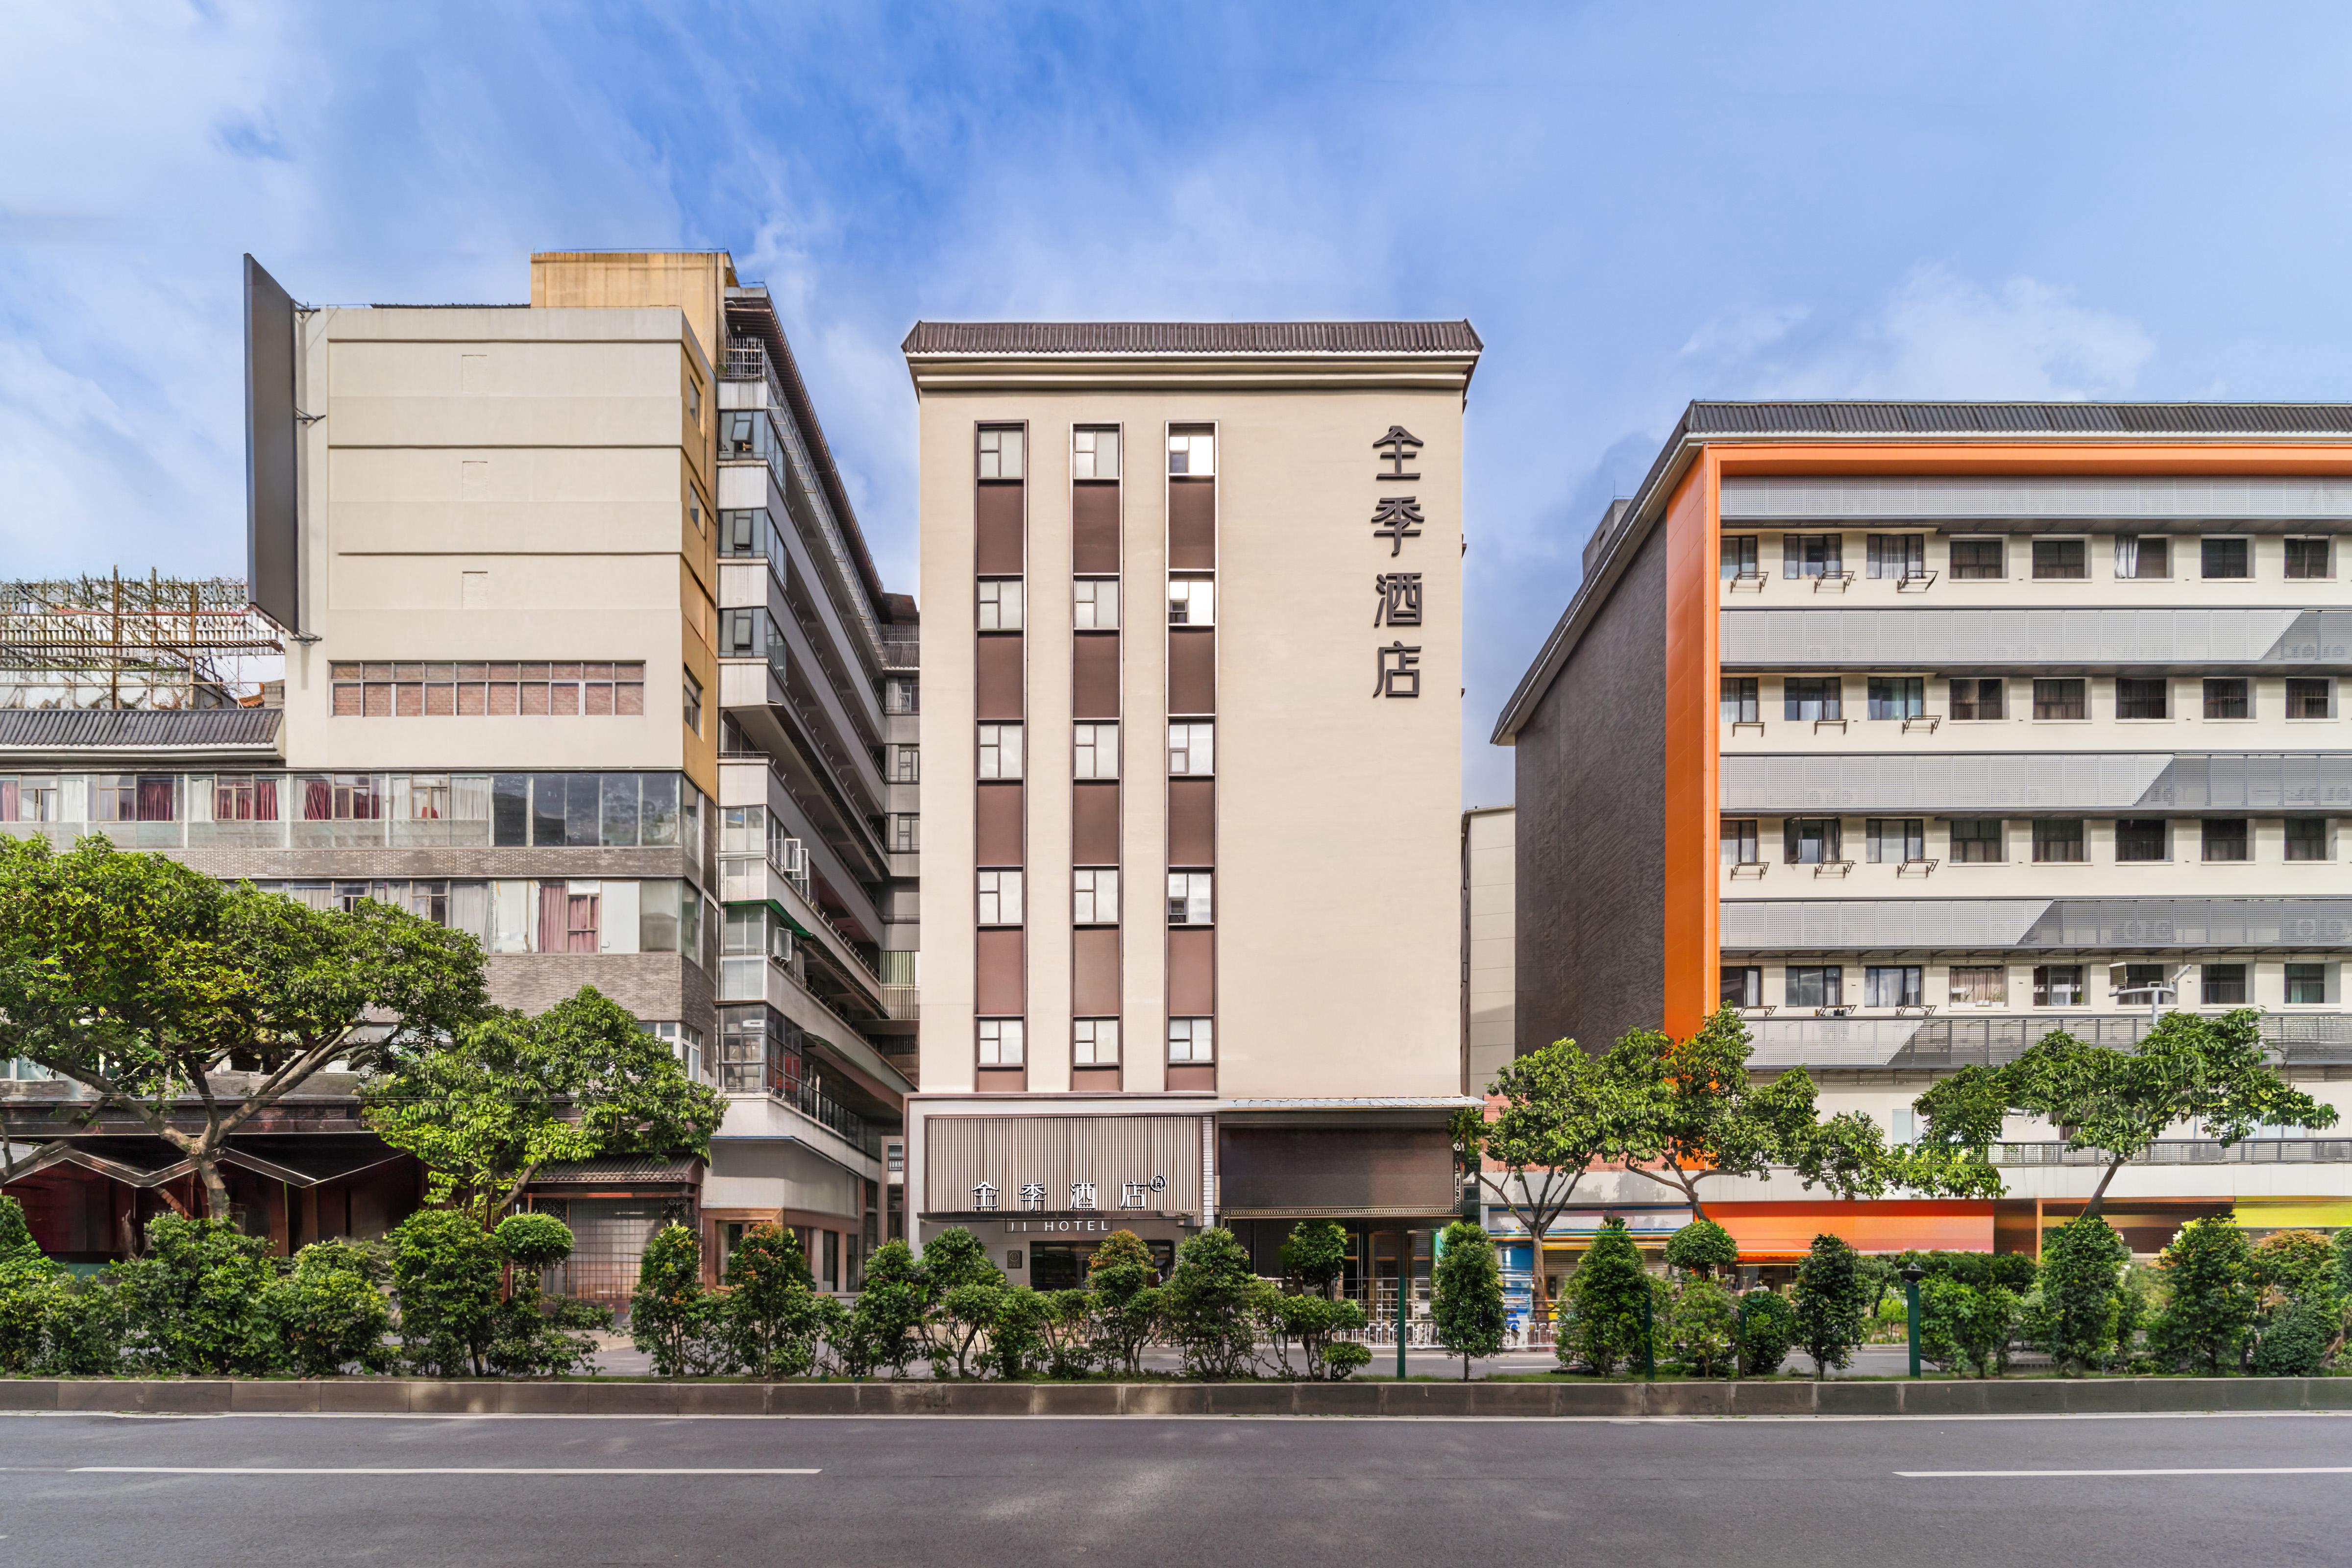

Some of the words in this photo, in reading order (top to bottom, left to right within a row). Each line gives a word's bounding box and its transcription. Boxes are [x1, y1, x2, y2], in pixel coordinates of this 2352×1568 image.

[1372, 425, 1425, 698] 全季酒店
[971, 1180, 1145, 1211] 全季酒店
[1011, 1222, 1026, 1232] JI
[1045, 1221, 1108, 1231] HOTEL
